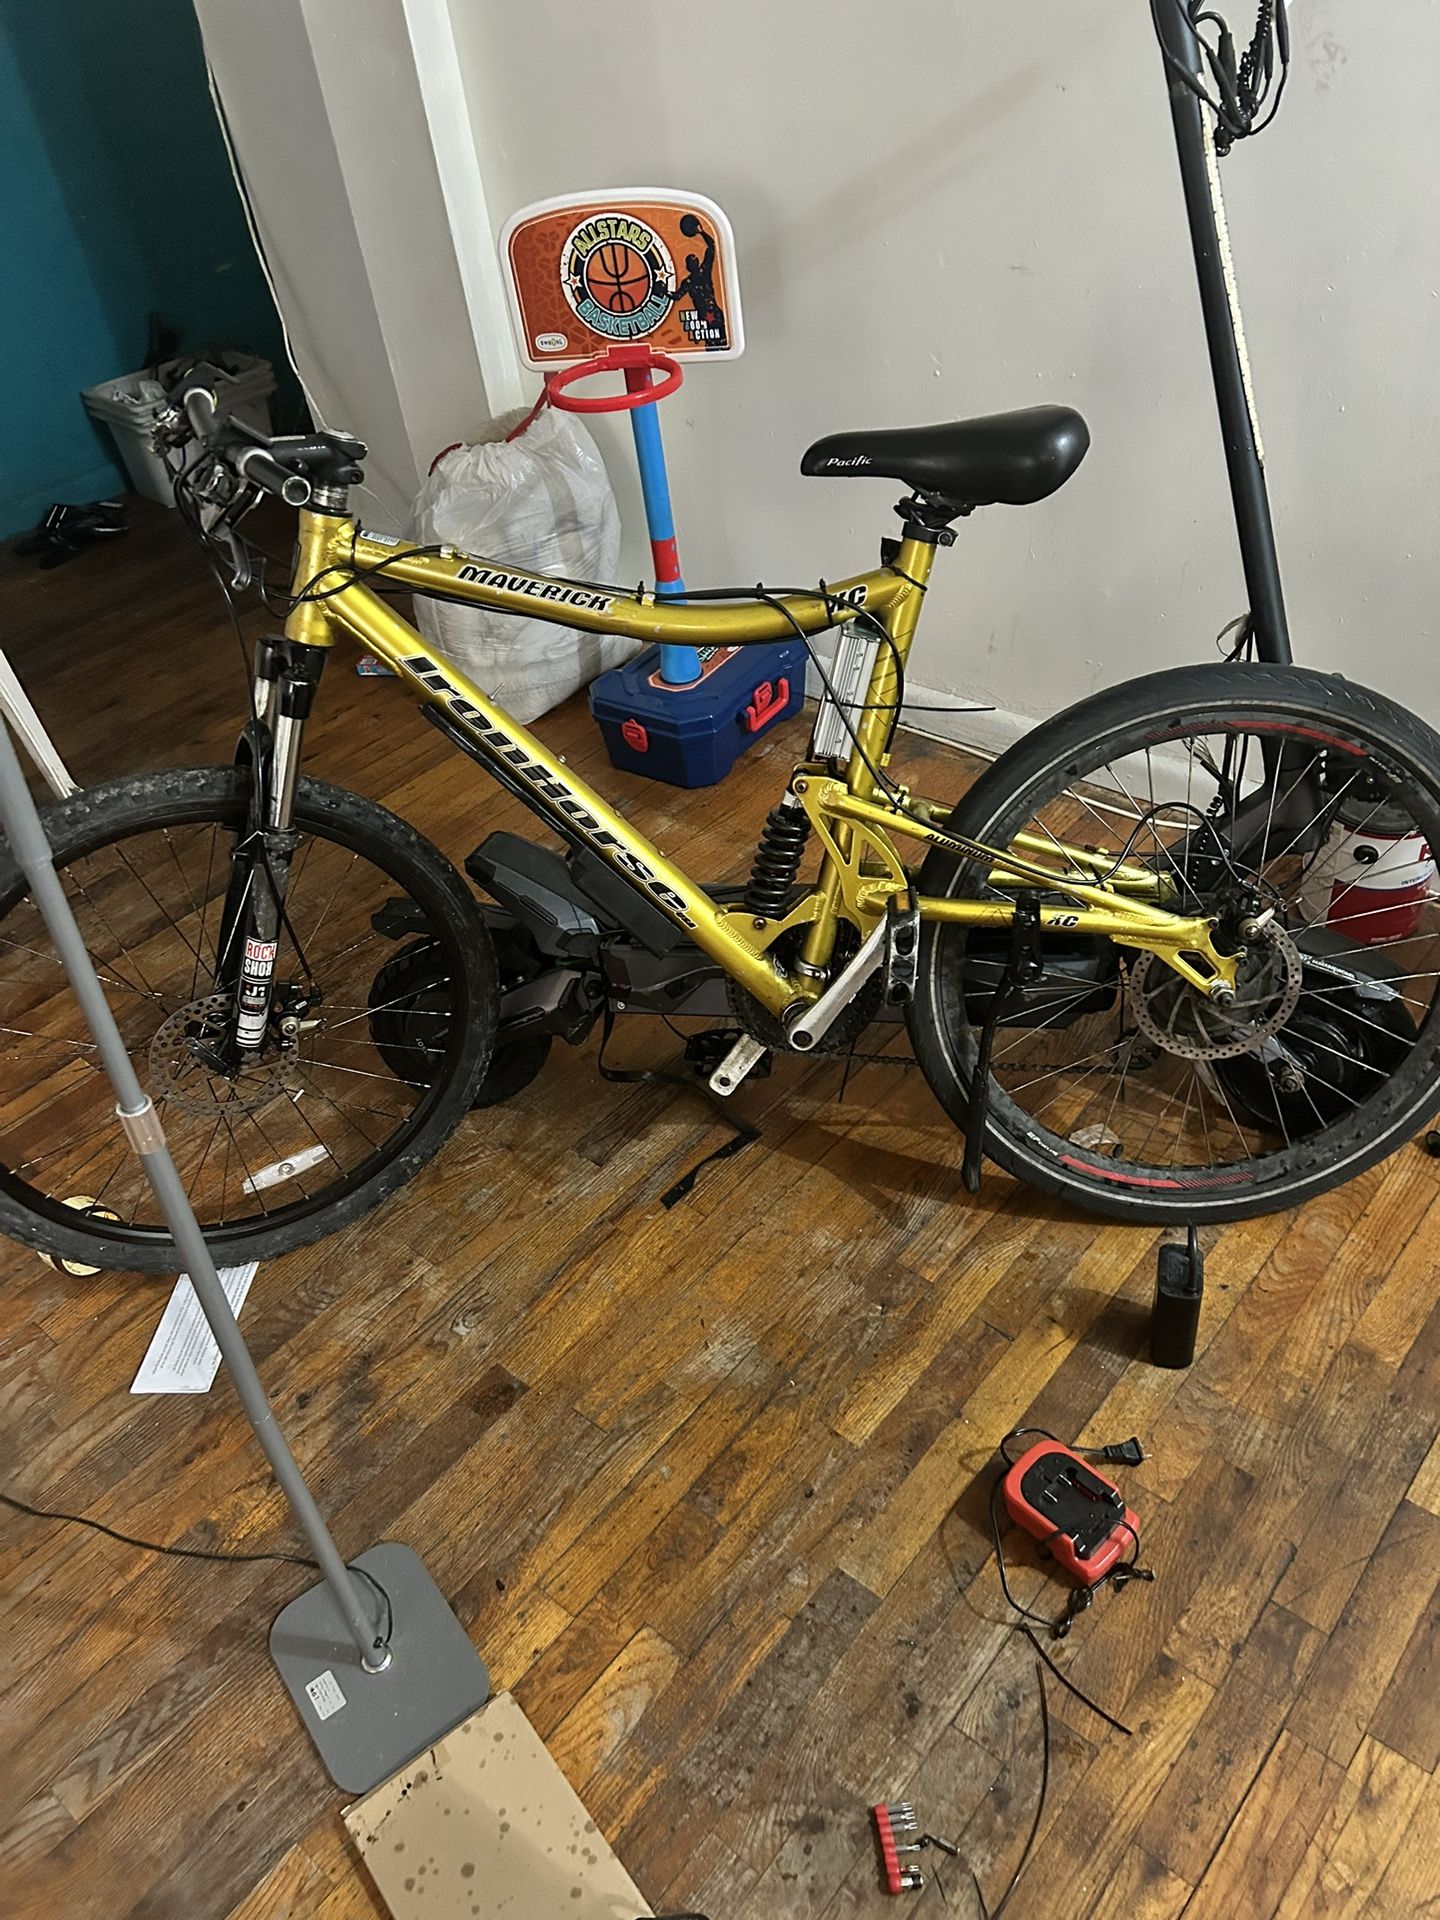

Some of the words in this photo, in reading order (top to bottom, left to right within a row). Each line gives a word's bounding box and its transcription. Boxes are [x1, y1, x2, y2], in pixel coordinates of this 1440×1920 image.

[572, 217, 652, 256] ALLSTARS
[576, 293, 669, 336] BASKETBALL
[826, 454, 873, 467] Pacific
[458, 564, 613, 612] MAVERICK
[924, 833, 994, 862] ALUMINUM
